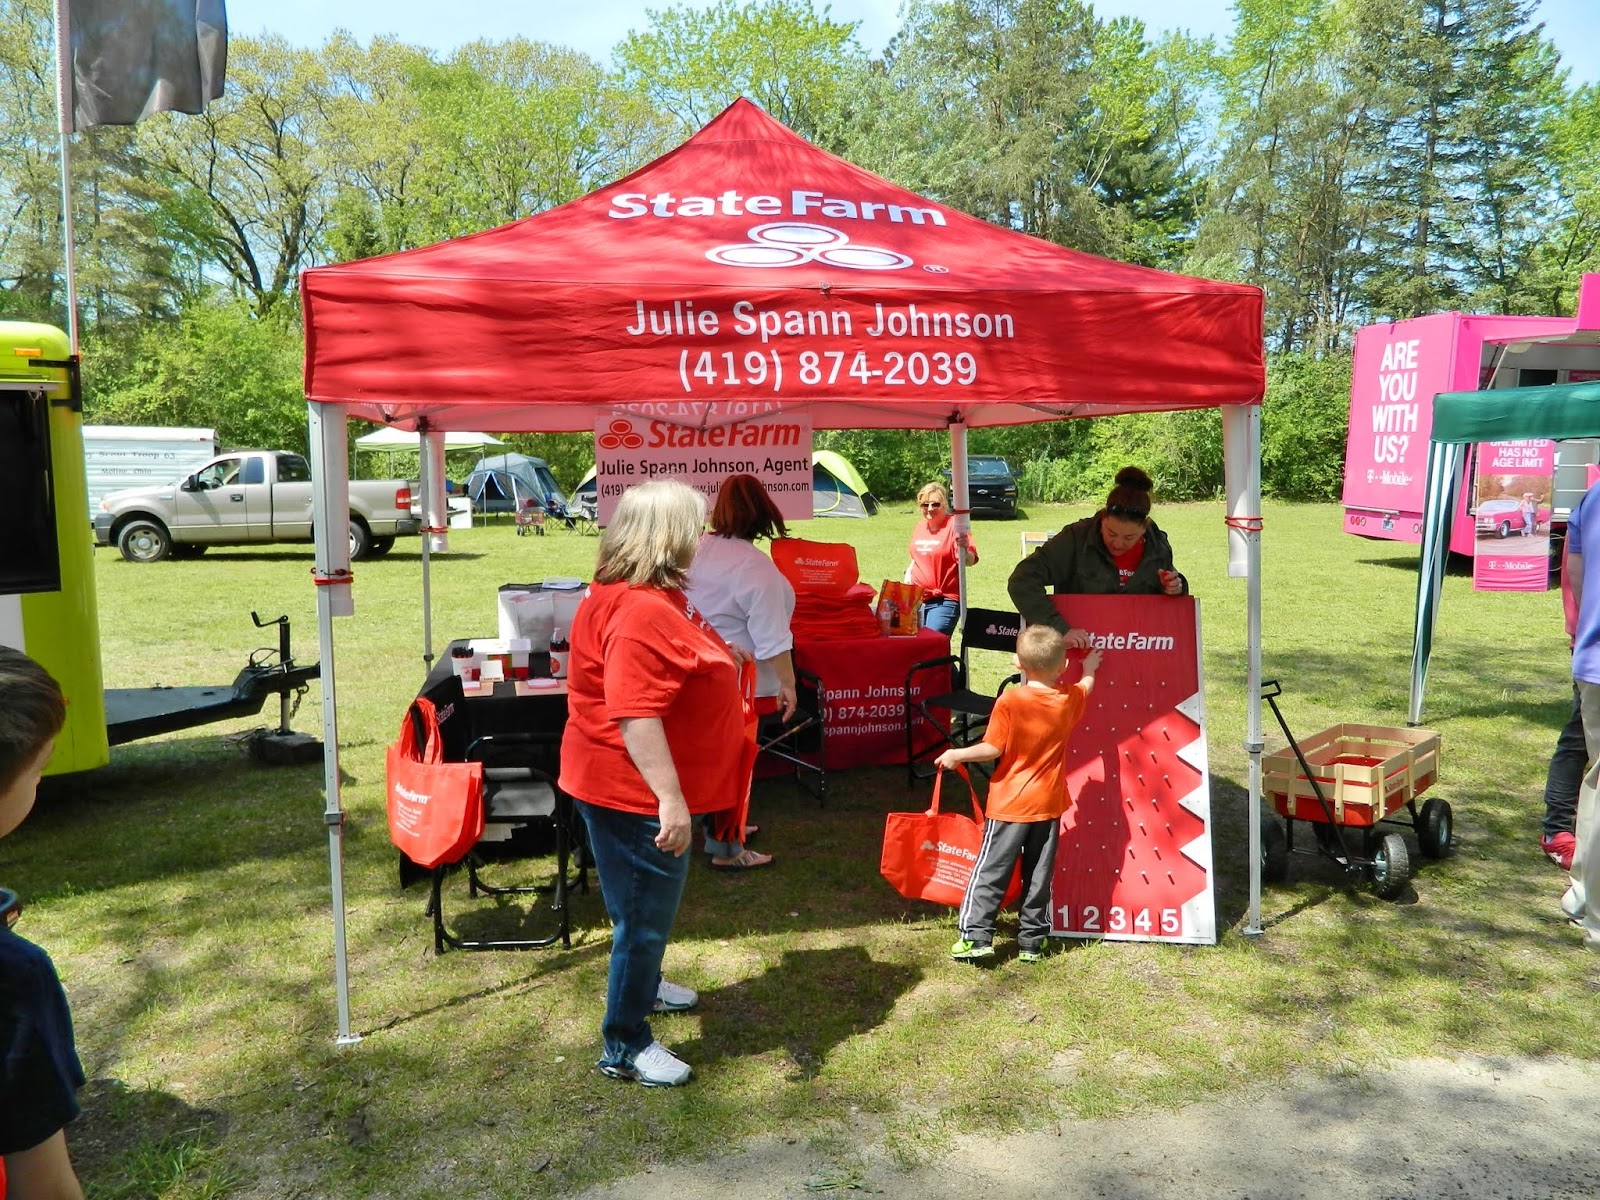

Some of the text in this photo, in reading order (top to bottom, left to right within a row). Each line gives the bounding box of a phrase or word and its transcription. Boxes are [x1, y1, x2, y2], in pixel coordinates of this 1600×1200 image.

[626, 300, 1015, 343] Julie Spann Johnson
[1379, 339, 1420, 372] ARE
[679, 349, 978, 392] (419) 874-2039
[1378, 371, 1418, 402] YOU
[1372, 403, 1419, 433] WITH
[1374, 435, 1409, 463] US?
[1491, 457, 1544, 468] AGE LIMIT
[1499, 447, 1539, 458] HAS NO
[600, 457, 809, 478] Julie Spann Johnson, Agent
[601, 483, 624, 498] (419)
[823, 687, 860, 702] pann
[838, 704, 905, 720] 874-2039
[1057, 904, 1179, 933] 1 2 3 4 5
